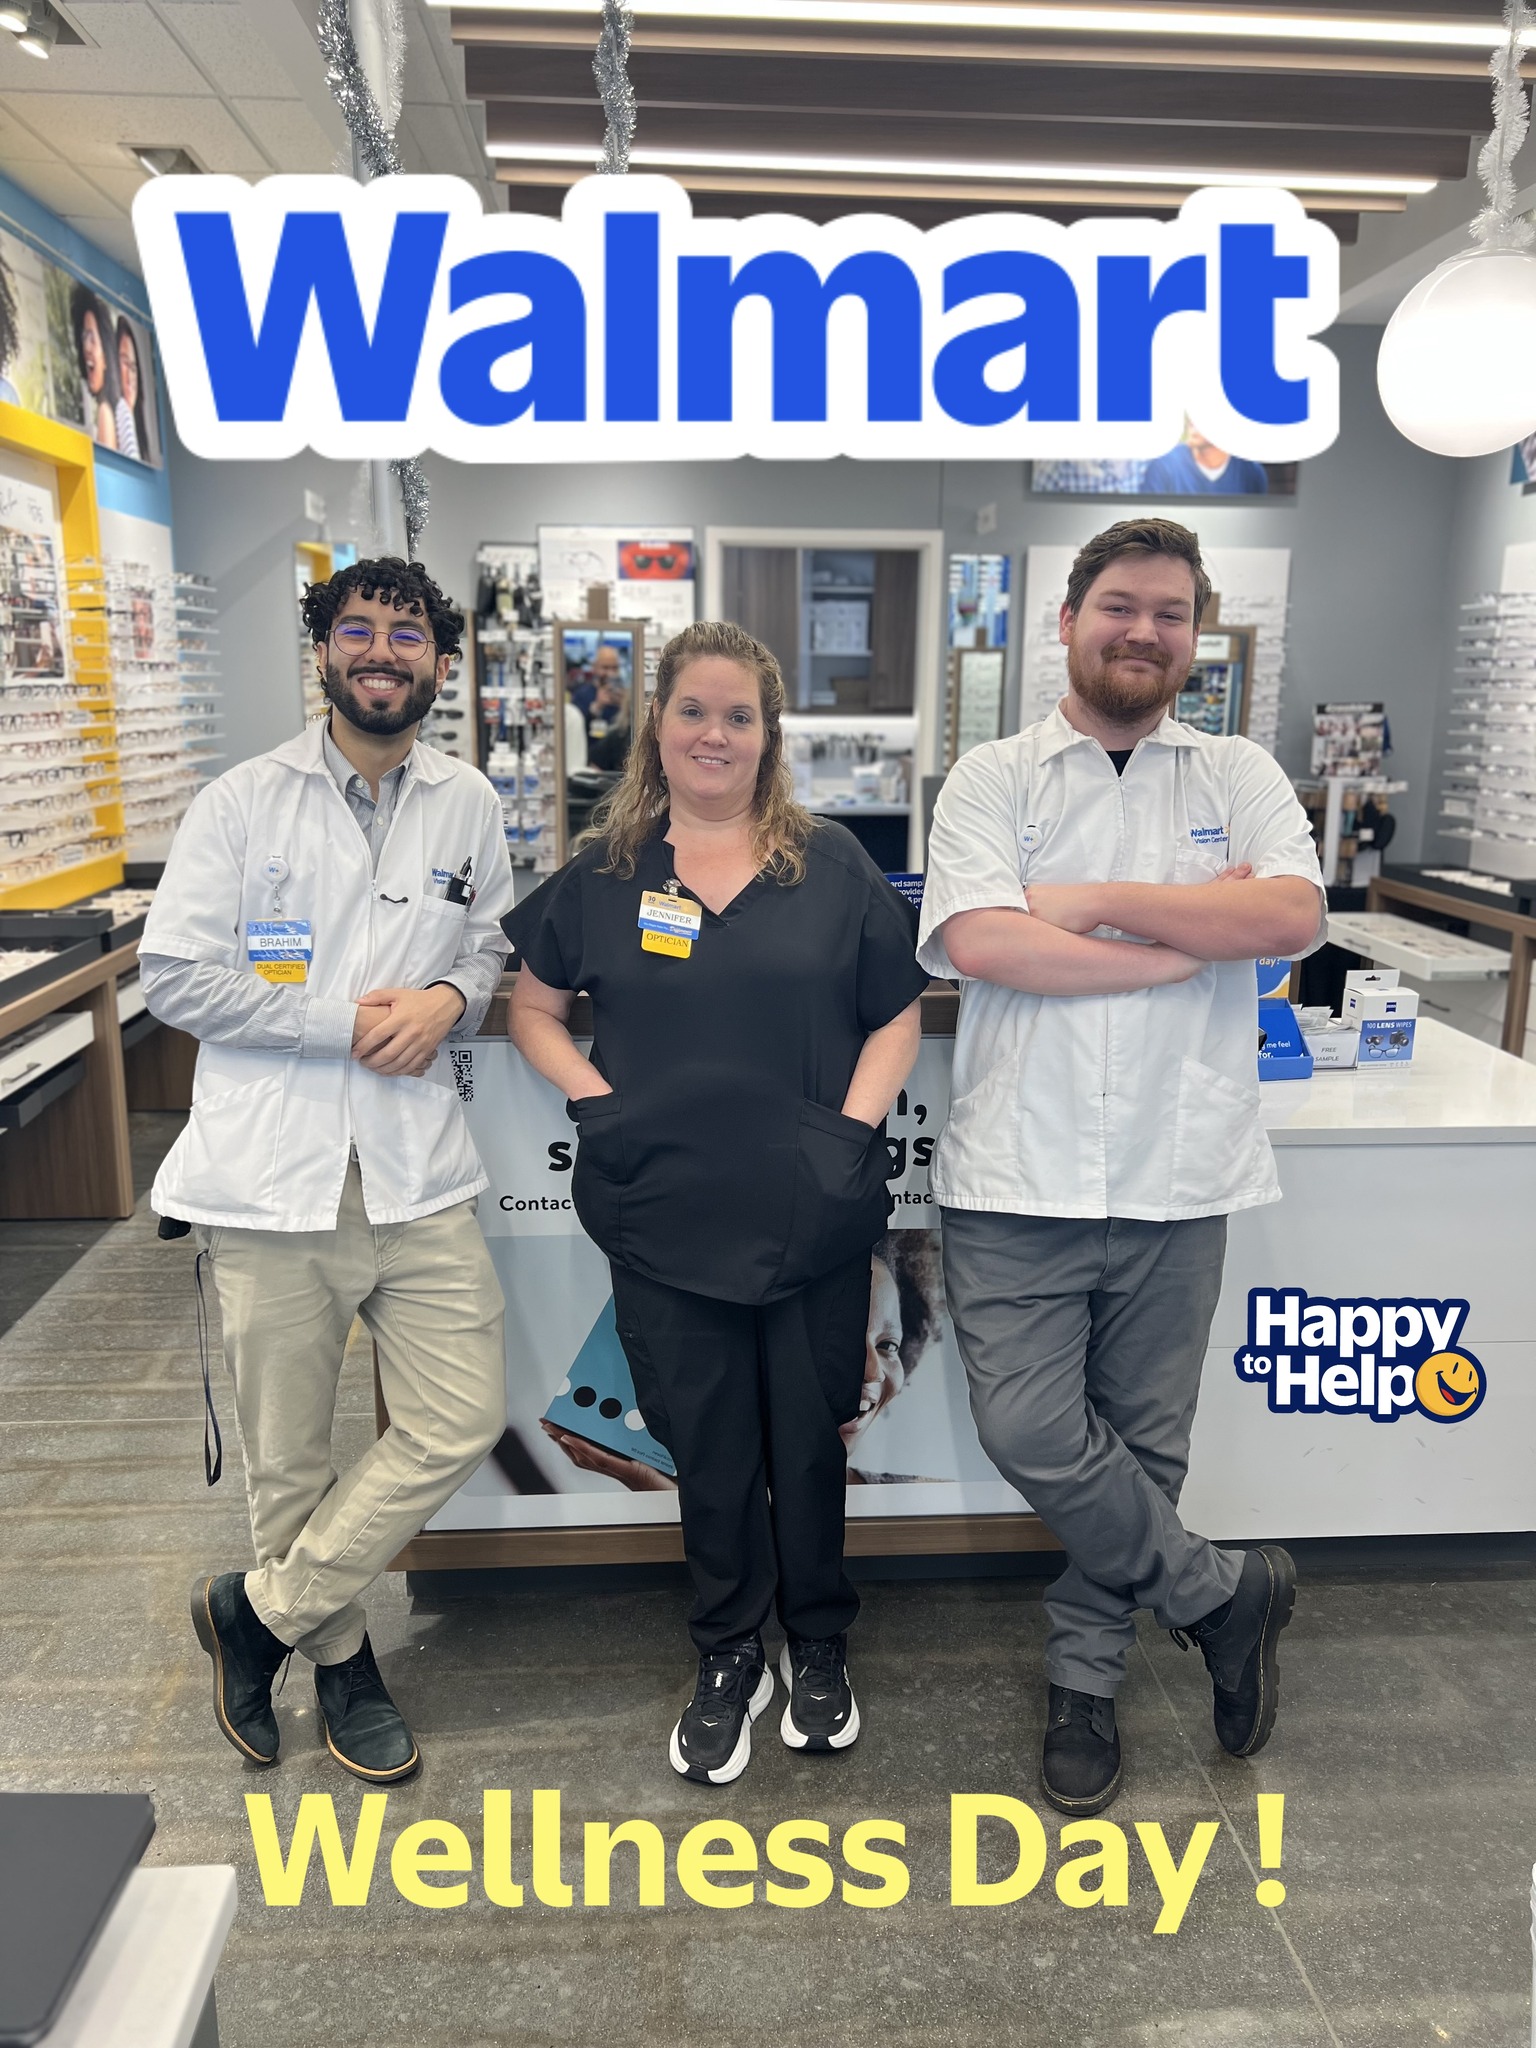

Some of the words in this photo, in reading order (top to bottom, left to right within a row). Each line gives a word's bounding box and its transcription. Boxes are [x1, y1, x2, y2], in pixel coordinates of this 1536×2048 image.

[1190, 826, 1224, 837] Walmart
[432, 868, 455, 879] Walma
[659, 901, 682, 911] Walmart
[647, 909, 692, 924] JENNIFER
[260, 937, 302, 947] BRAHIM
[646, 933, 689, 947] OPTICIAN
[1278, 1040, 1291, 1048] feel
[499, 1195, 572, 1212] Contac
